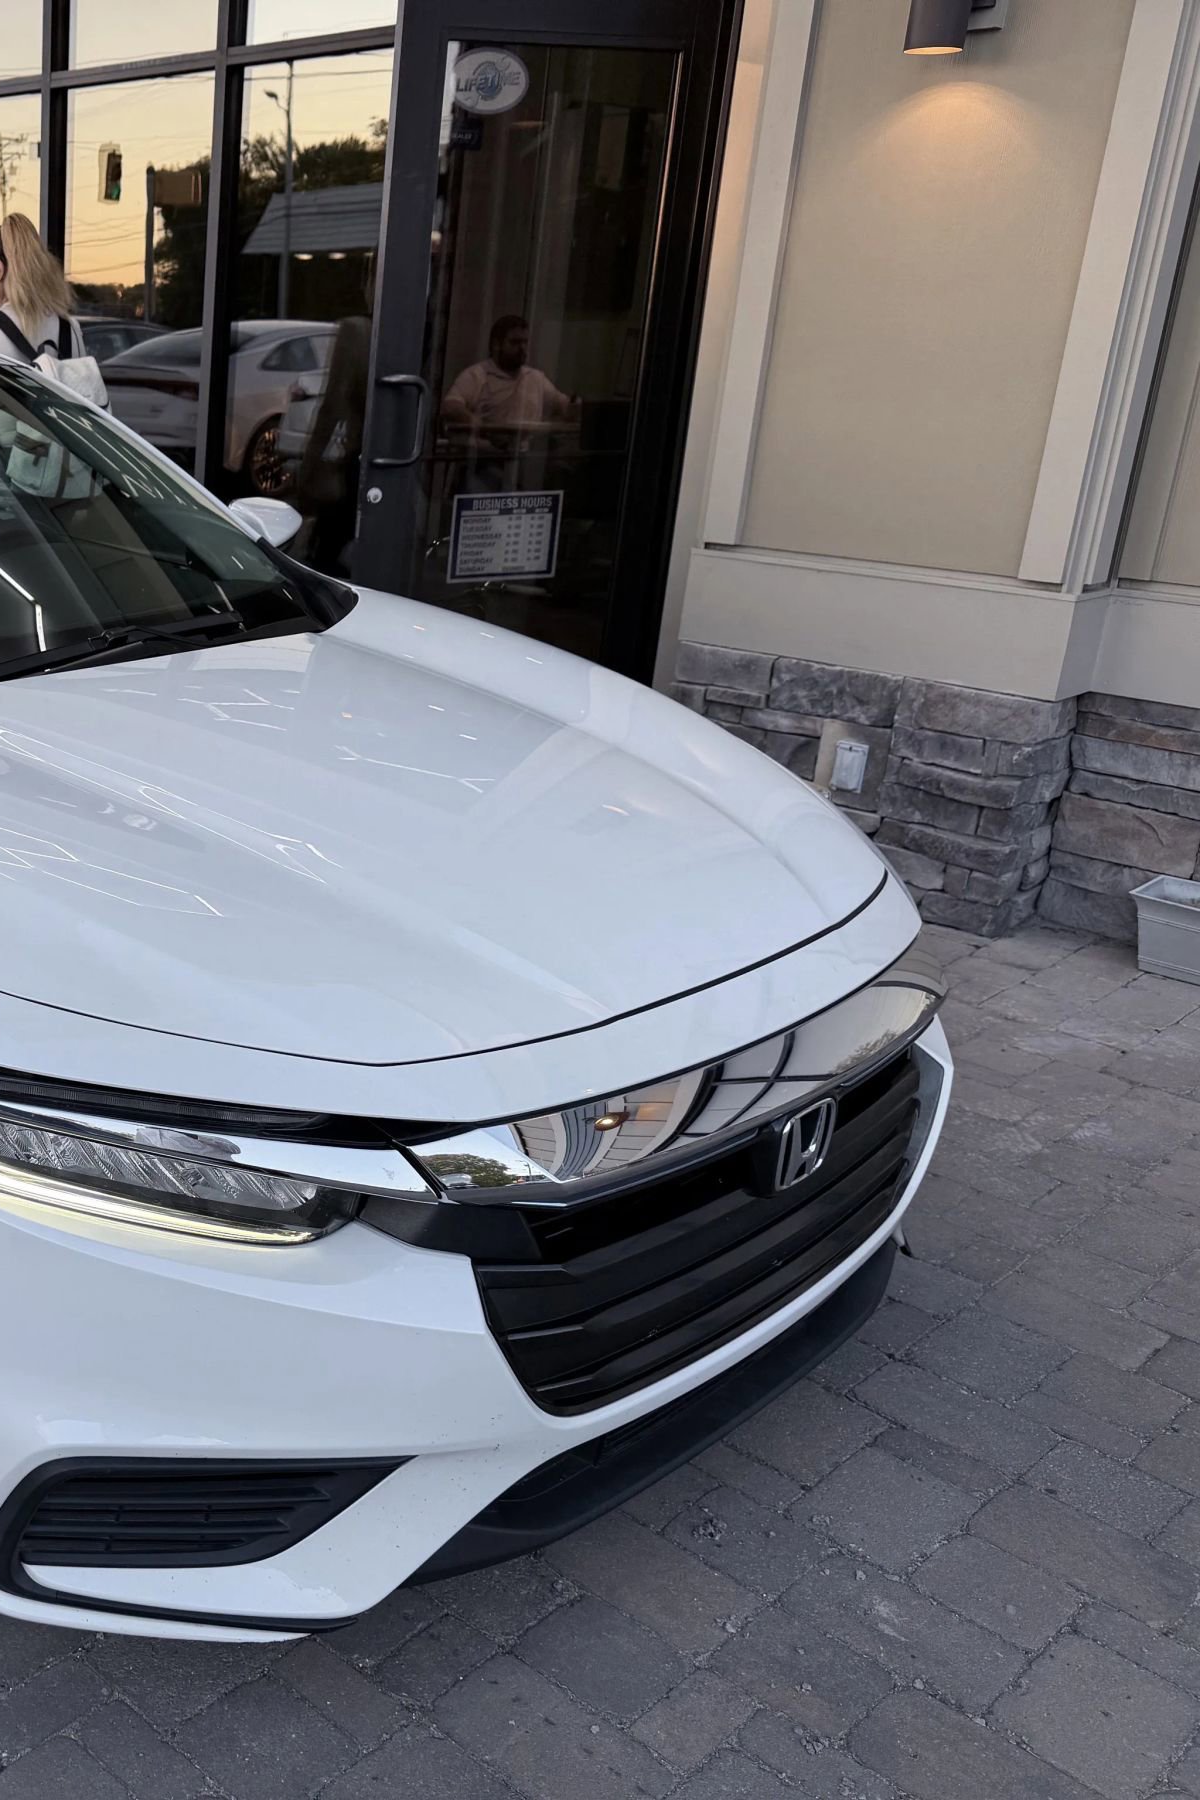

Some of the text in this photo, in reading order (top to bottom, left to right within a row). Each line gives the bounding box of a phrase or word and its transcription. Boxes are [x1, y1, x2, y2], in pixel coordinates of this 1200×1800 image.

[456, 71, 521, 92] LIFETIME
[473, 497, 552, 510] BUSINESS HOURS
